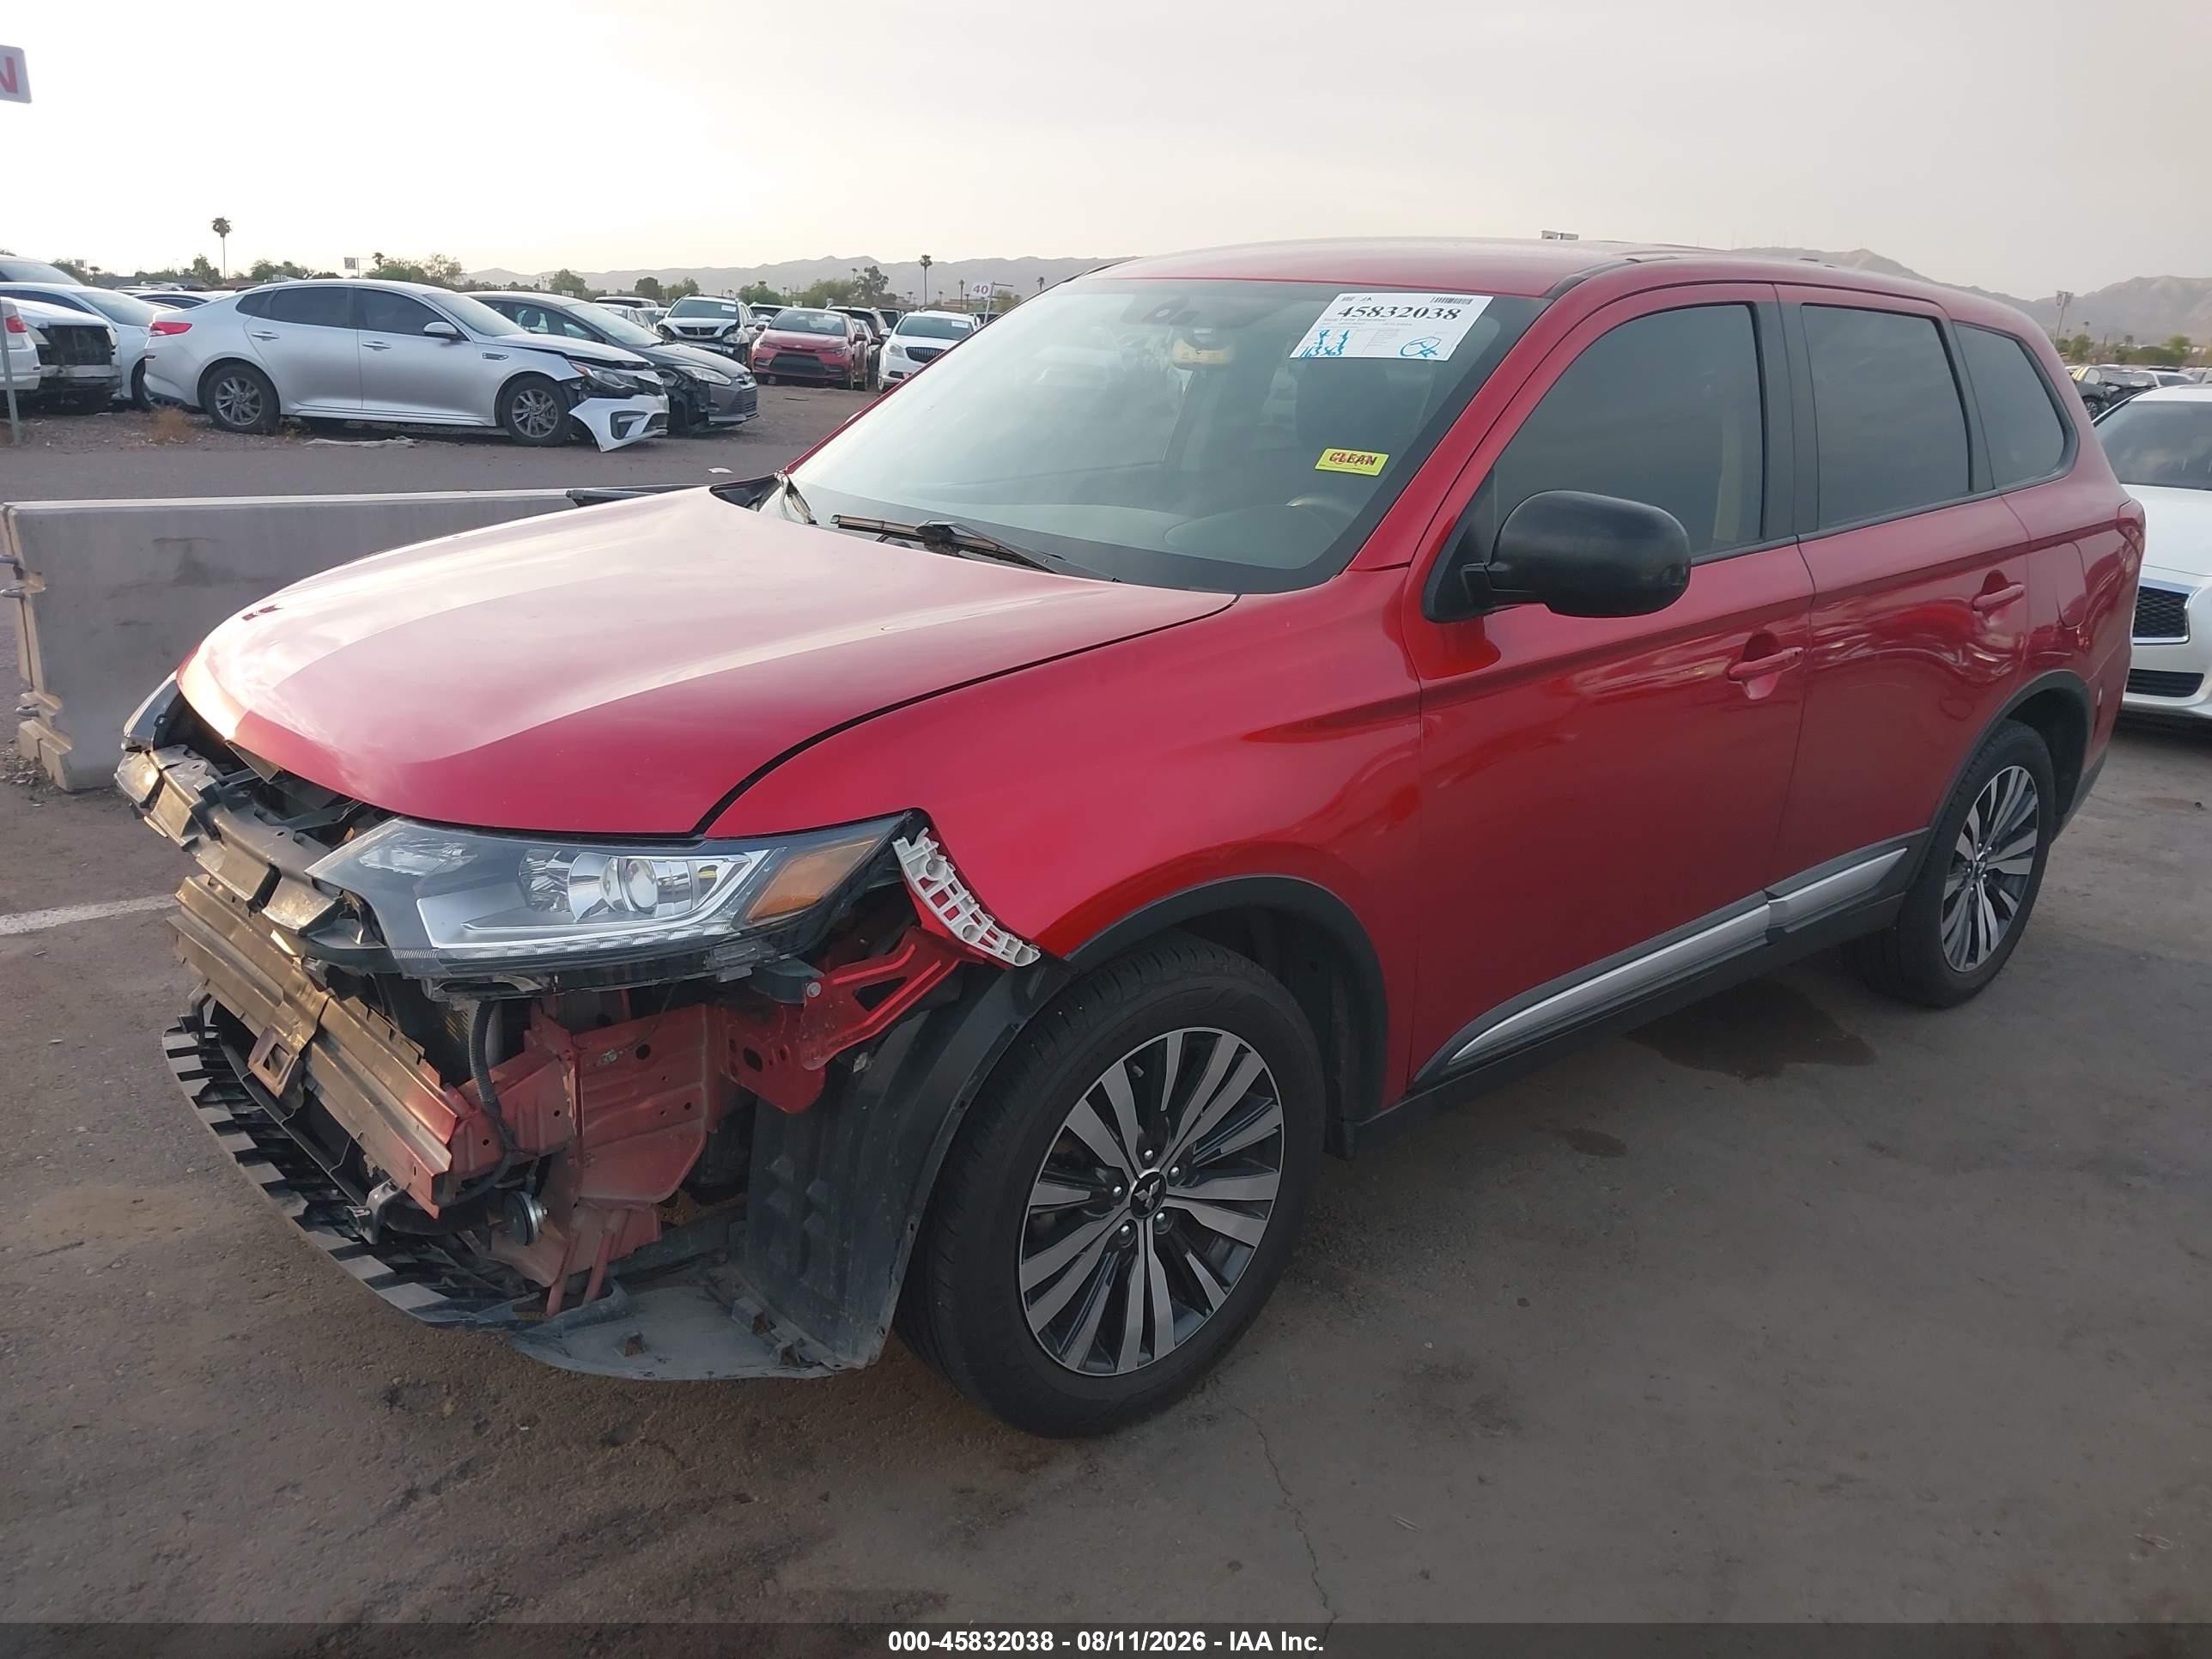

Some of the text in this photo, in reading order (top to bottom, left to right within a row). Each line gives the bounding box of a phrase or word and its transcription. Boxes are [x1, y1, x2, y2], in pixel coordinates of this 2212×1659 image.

[973, 284, 988, 295] 40
[1338, 305, 1462, 320] 45832038
[1329, 452, 1377, 465] CLEAN
